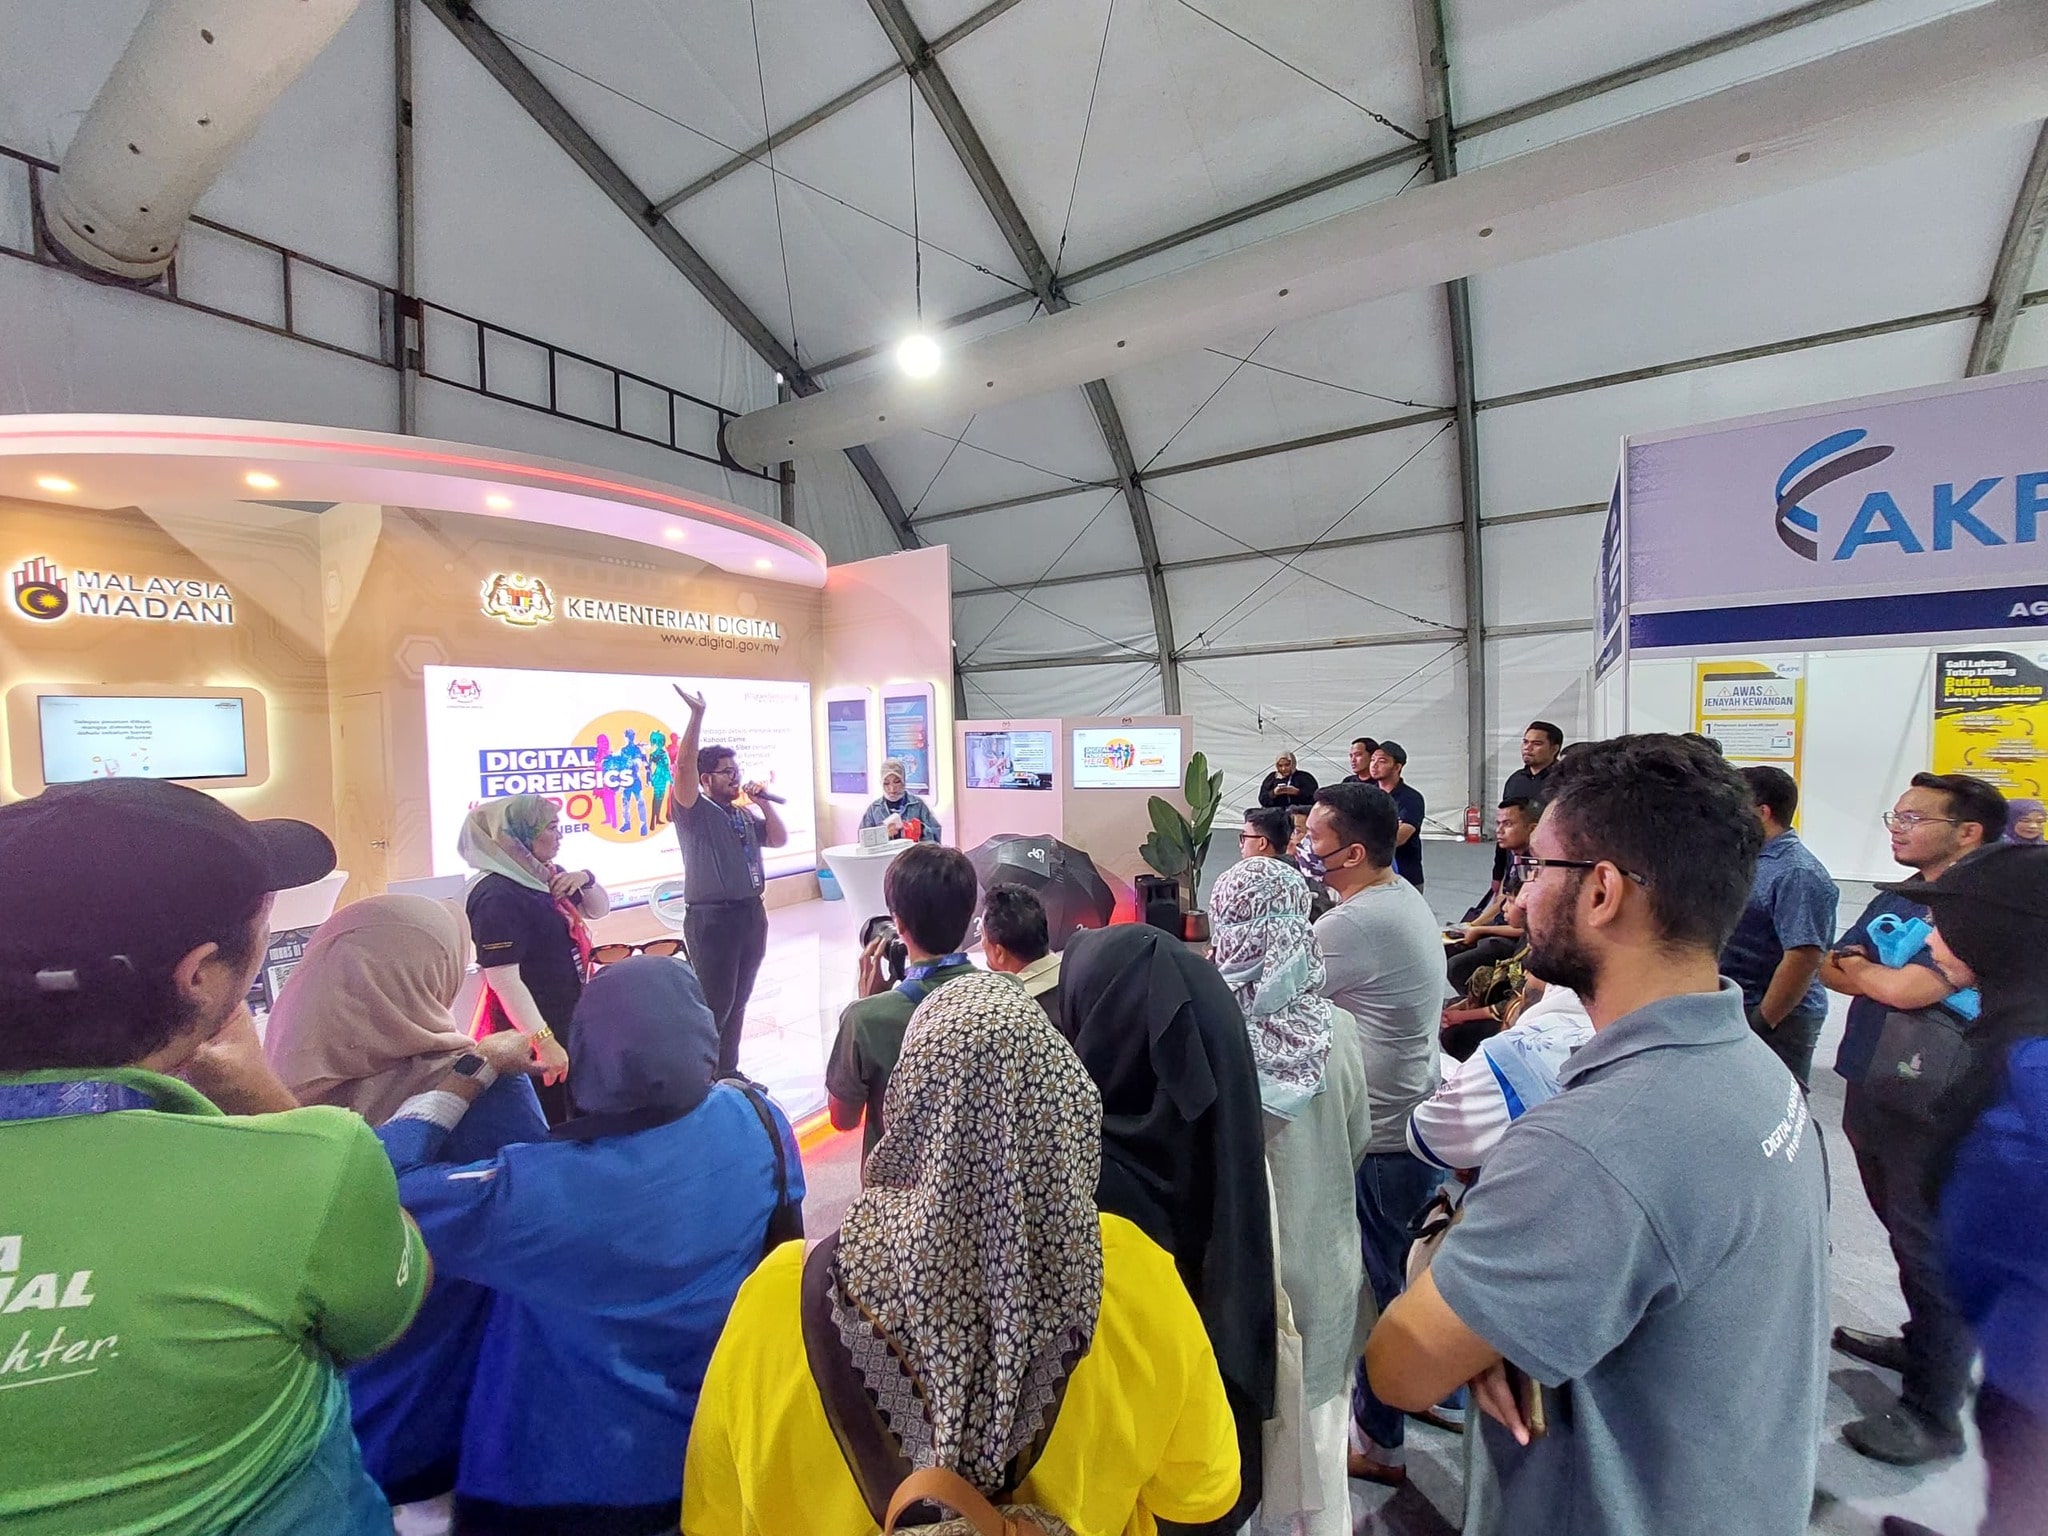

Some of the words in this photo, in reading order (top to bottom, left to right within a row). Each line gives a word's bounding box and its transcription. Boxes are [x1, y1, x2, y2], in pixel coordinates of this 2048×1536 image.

[77, 570, 232, 600] MALAYSIA
[79, 592, 234, 624] MADANI
[568, 597, 711, 631] KEMENTERIAN
[718, 616, 781, 639] DIGITAL
[661, 633, 780, 655] www.digital.gov.my
[1944, 677, 1990, 687] Bukan
[1732, 685, 1763, 697] AWAS
[1944, 685, 2043, 697] Penyelesaian
[1704, 697, 1740, 707] JENAYAH
[1742, 697, 1793, 706] KEWANGAN
[1705, 723, 1711, 735] 1
[486, 749, 596, 772] DIGITAL
[487, 769, 634, 796] FORENSICS
[560, 823, 590, 835] IBER
